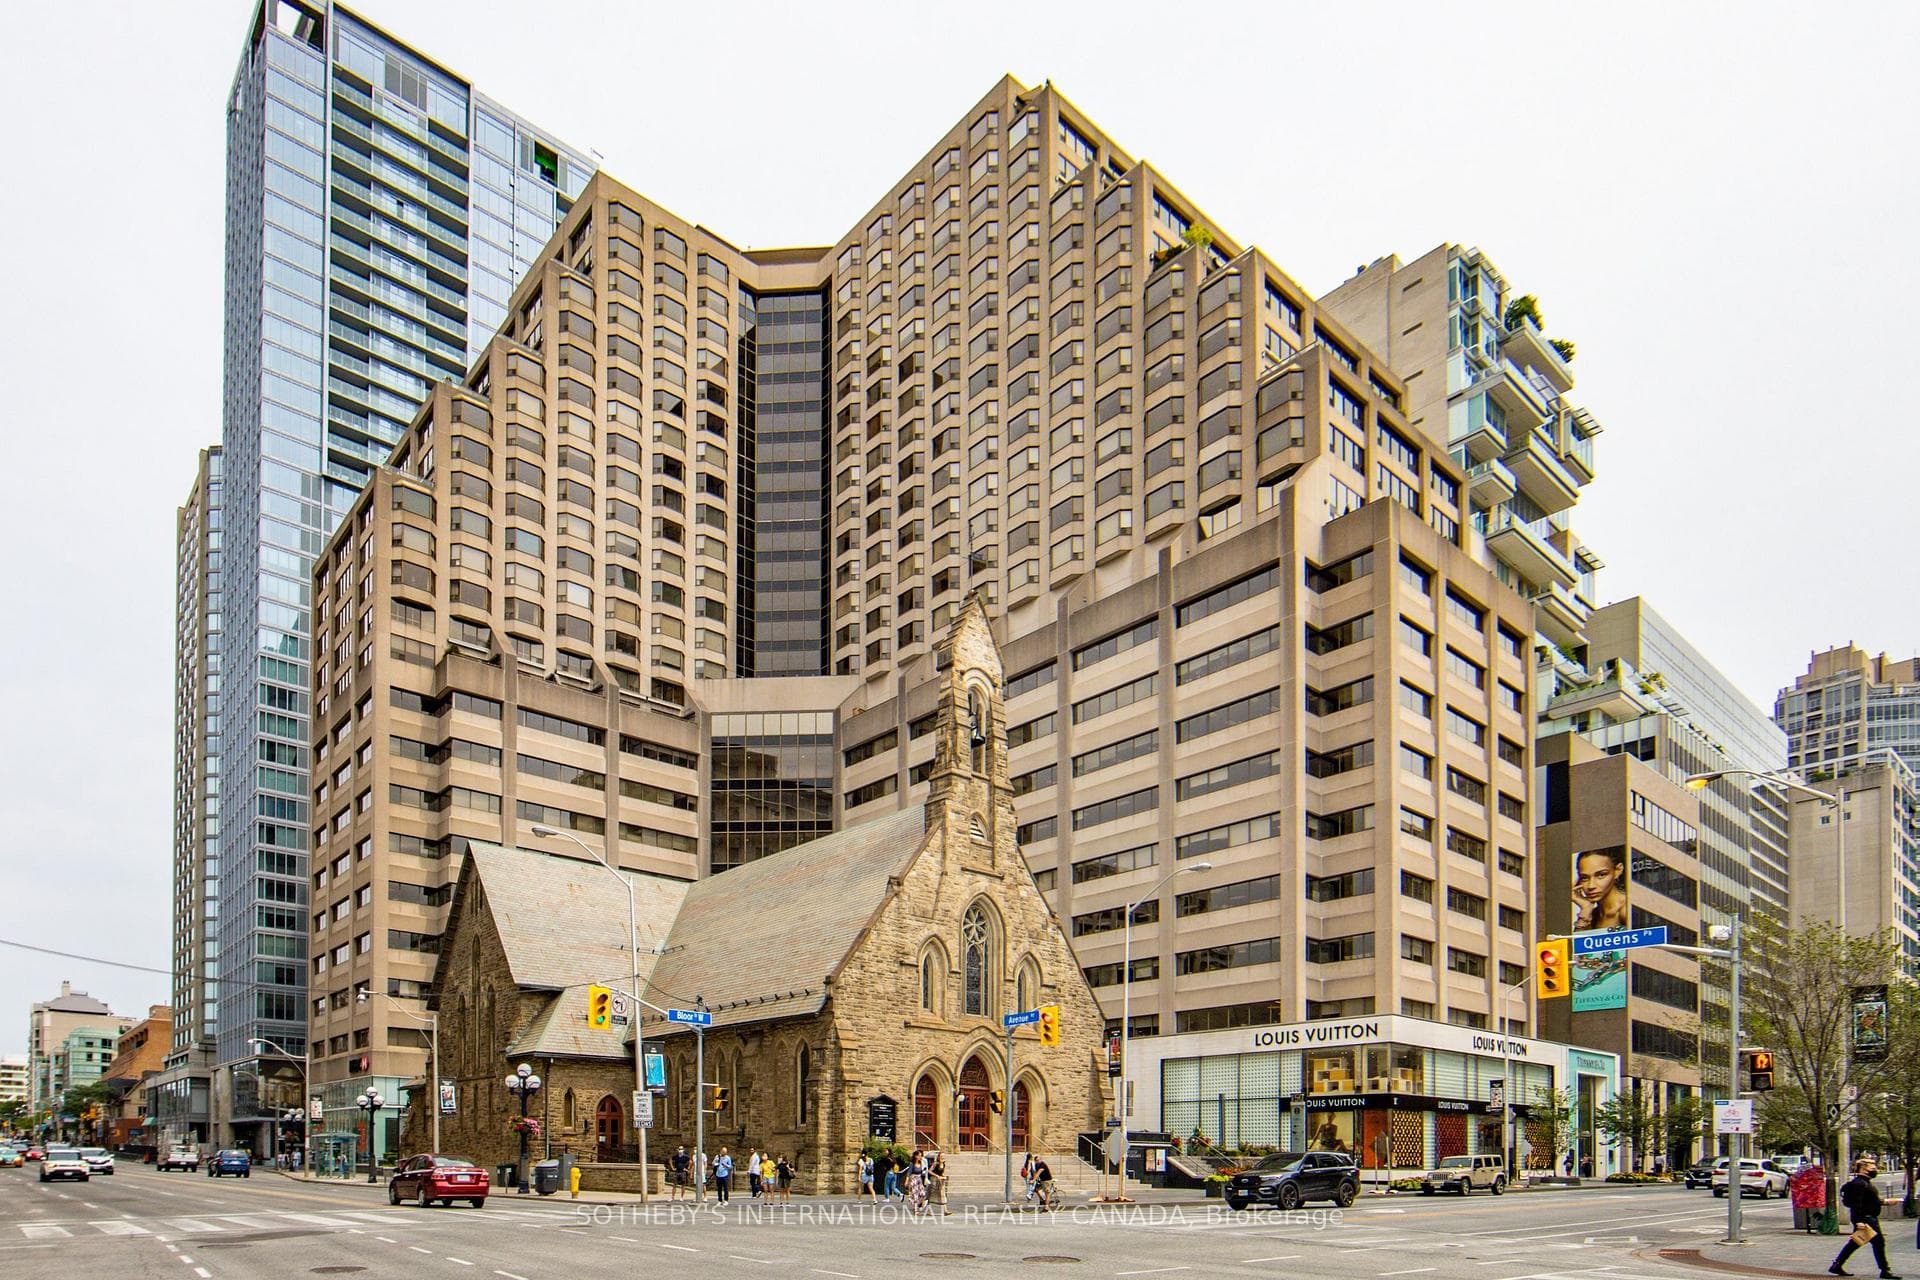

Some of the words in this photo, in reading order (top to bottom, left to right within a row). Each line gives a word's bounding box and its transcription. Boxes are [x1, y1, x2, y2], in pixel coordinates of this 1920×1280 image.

[1583, 933, 1639, 949] Queens
[676, 1011, 693, 1020] Bloor
[1008, 1015, 1028, 1024] Avenue
[1255, 1030, 1299, 1046] LOUIS
[1305, 1022, 1378, 1041] VUITTON
[1473, 1036, 1494, 1052] LOUIS
[1497, 1040, 1527, 1056] VUTTON
[1306, 1099, 1326, 1108] OUIS
[1328, 1098, 1365, 1107] VUITTON
